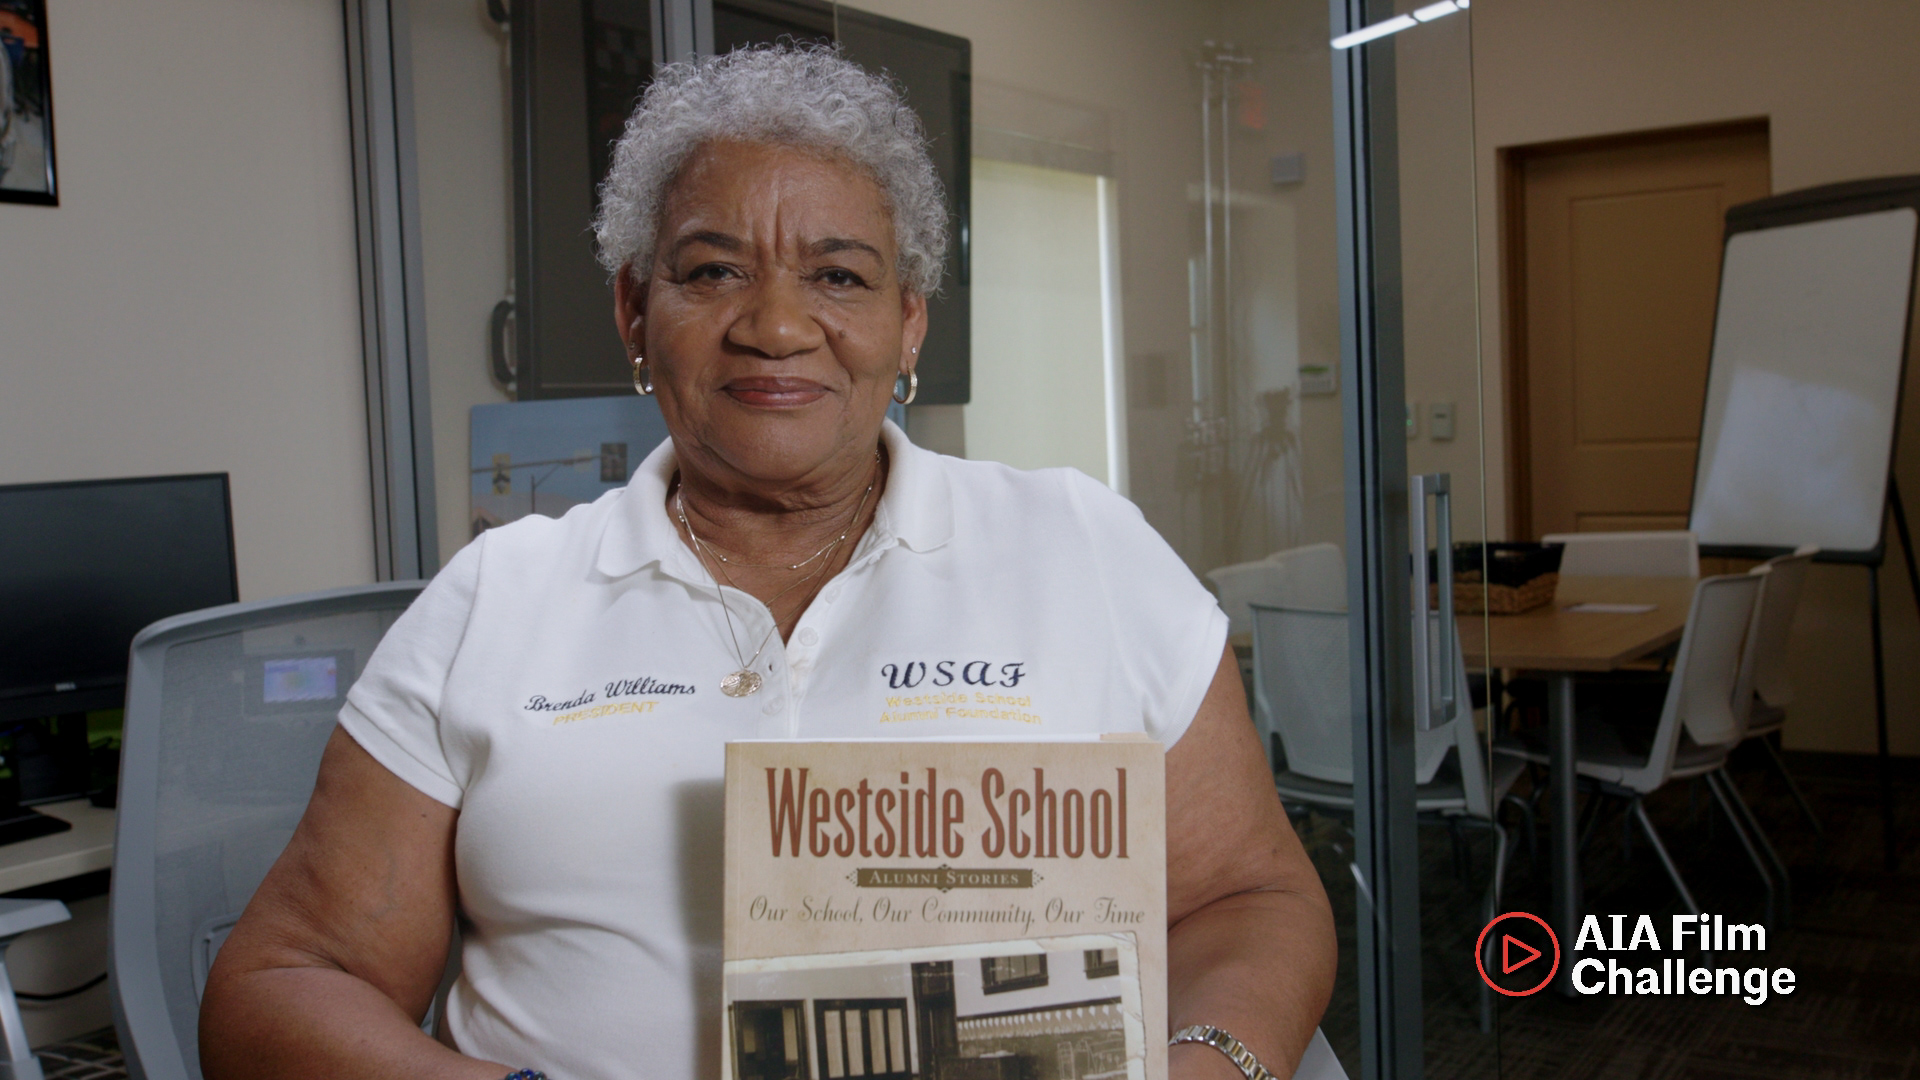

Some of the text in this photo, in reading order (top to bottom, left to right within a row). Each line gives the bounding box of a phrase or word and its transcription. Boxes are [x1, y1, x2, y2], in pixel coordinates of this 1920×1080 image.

[881, 660, 1025, 689] WSAF
[524, 676, 696, 712] Brenda Williams
[886, 692, 1031, 708] Westside School
[553, 701, 659, 726] PRESIDENT
[880, 707, 1042, 725] Alumni Foundation
[765, 767, 1129, 858] Westside School
[749, 895, 788, 922] Our
[800, 896, 864, 924] School,
[872, 896, 912, 923] Our
[1045, 897, 1085, 923] Our
[1094, 896, 1145, 924] Time
